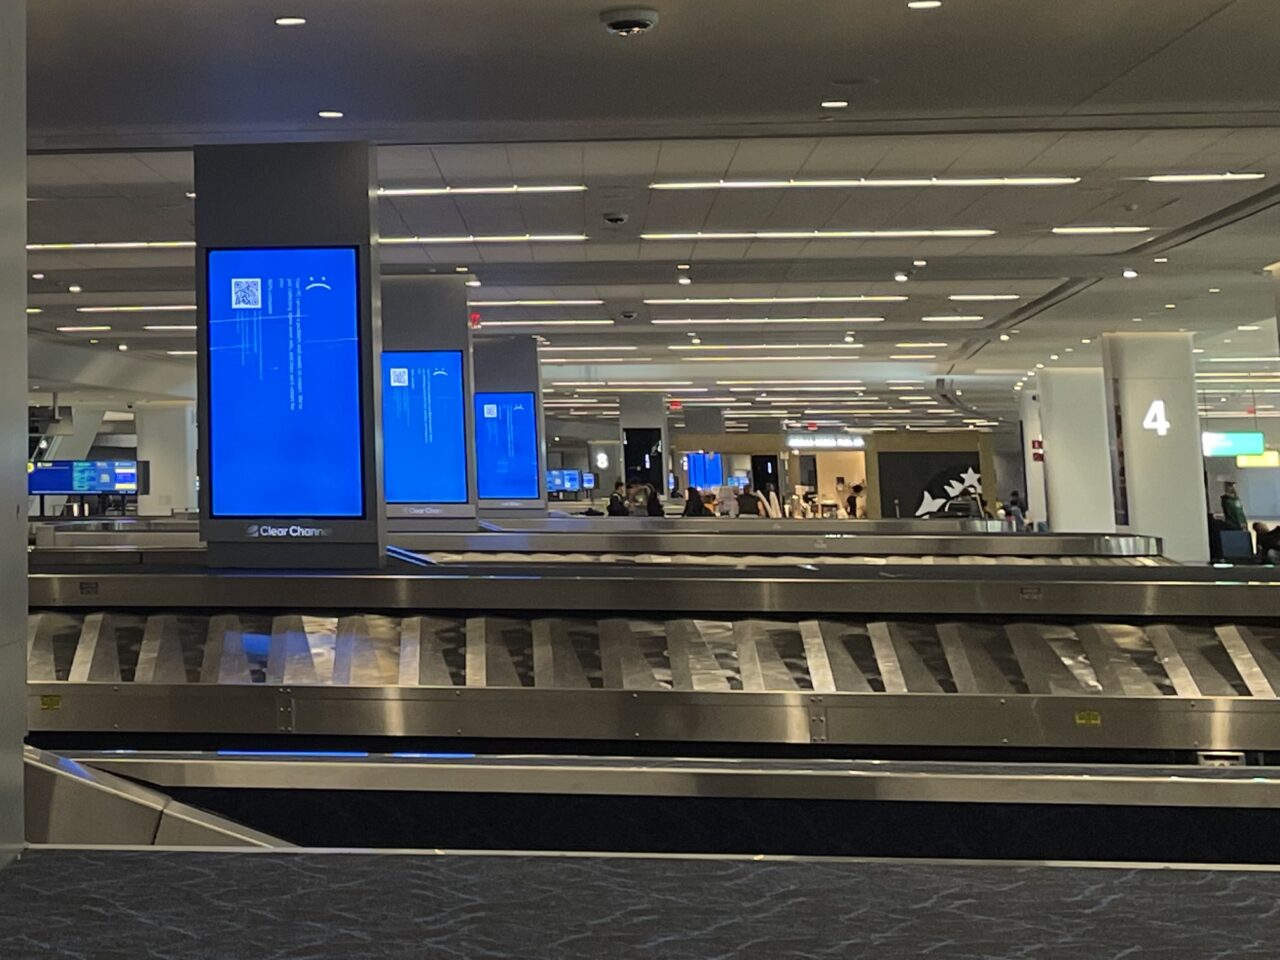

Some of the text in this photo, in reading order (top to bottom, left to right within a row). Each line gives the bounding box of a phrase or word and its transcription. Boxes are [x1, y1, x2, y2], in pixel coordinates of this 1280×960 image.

[1142, 400, 1170, 436] 4
[260, 525, 334, 536] Clear Channe
